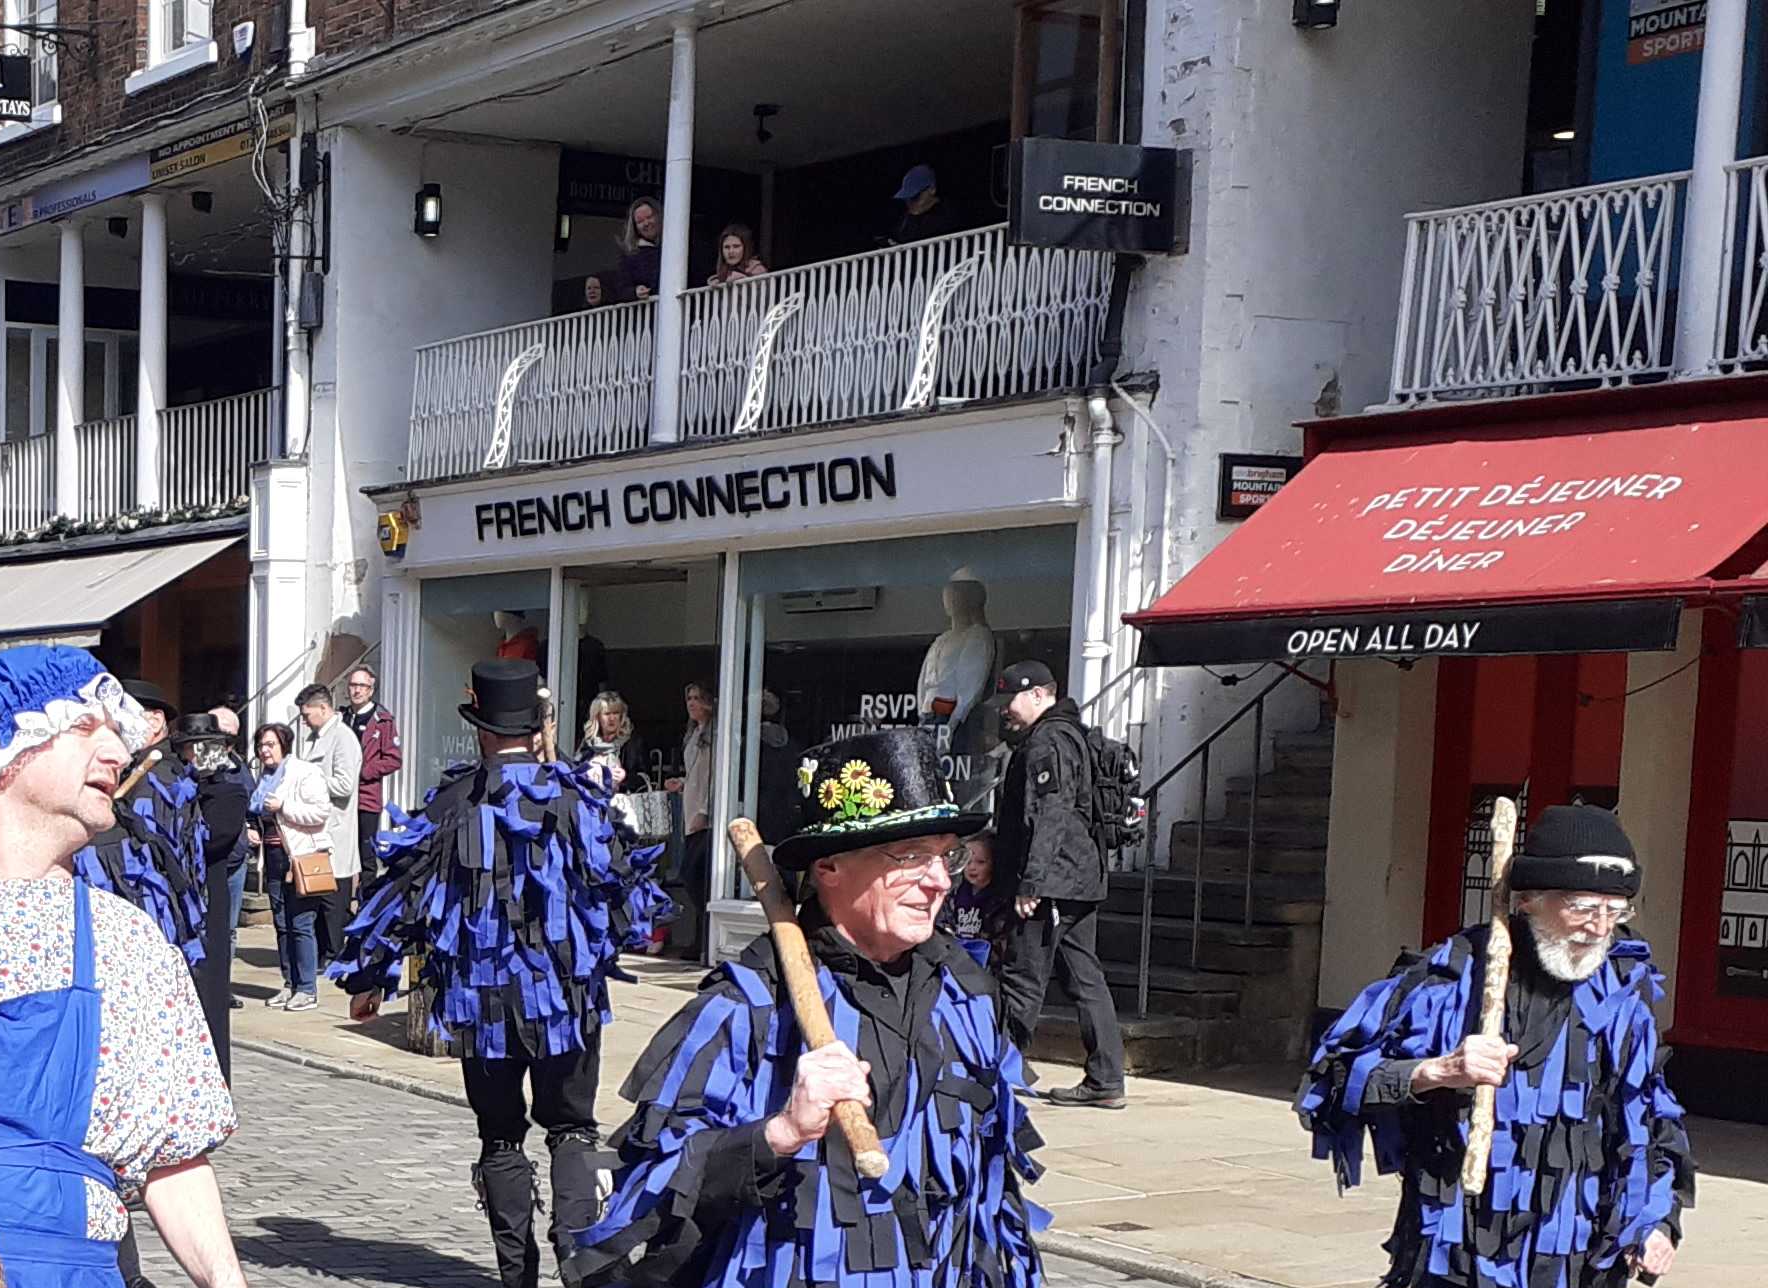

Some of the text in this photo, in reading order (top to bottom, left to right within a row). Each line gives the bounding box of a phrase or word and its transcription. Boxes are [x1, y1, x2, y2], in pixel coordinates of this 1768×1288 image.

[174, 125, 235, 151] APPOINTMENT
[181, 153, 207, 169] SALON
[1063, 175, 1138, 194] FRENCH
[1039, 195, 1161, 217] CONNECTION
[475, 453, 897, 541] FRENCH CONNECTION
[1362, 474, 1683, 517] PETIT DÉJEUNER
[1383, 512, 1587, 542] DÉJEUNER
[1383, 547, 1505, 574] DÎNER
[1287, 622, 1481, 654] OPEN ALL DAY
[860, 693, 917, 719] RSVP
